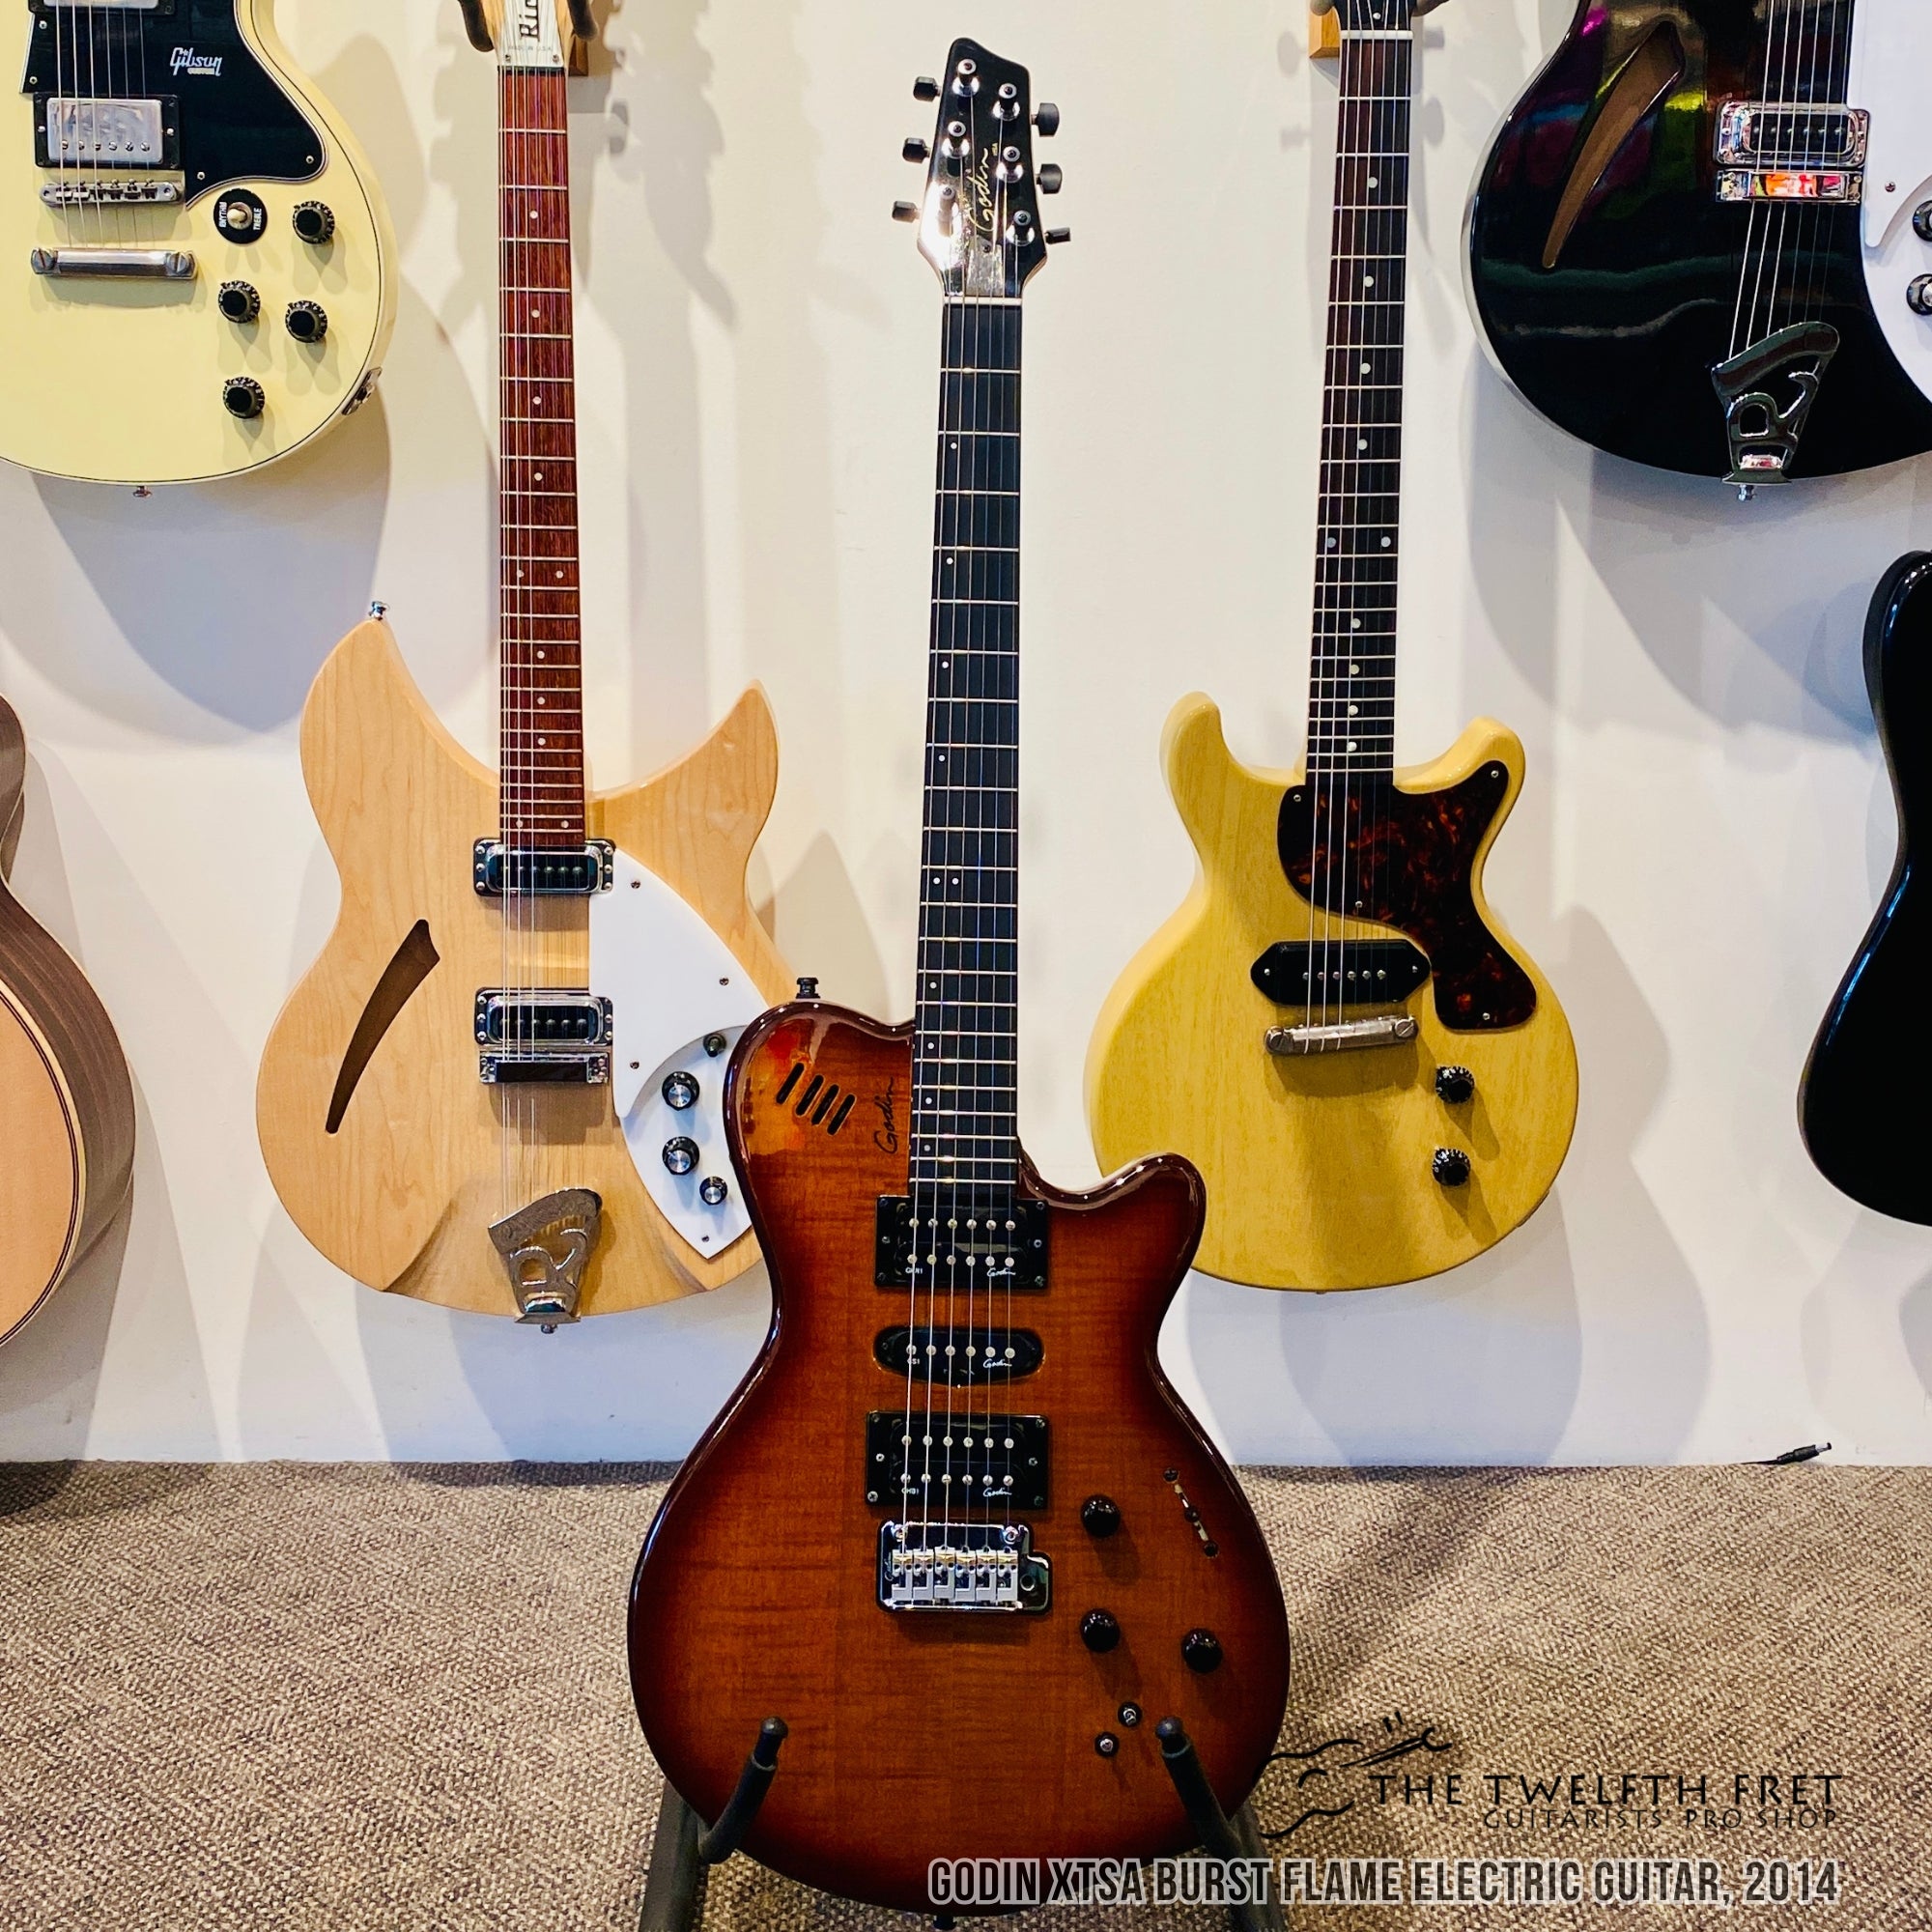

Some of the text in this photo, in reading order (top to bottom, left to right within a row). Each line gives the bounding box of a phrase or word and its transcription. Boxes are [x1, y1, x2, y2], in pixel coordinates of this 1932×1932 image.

[169, 46, 223, 76] Gibson
[966, 148, 996, 232] Godin
[873, 1076, 898, 1154] Godin
[982, 1358, 1012, 1368] Godin
[982, 1488, 1012, 1497] Godin
